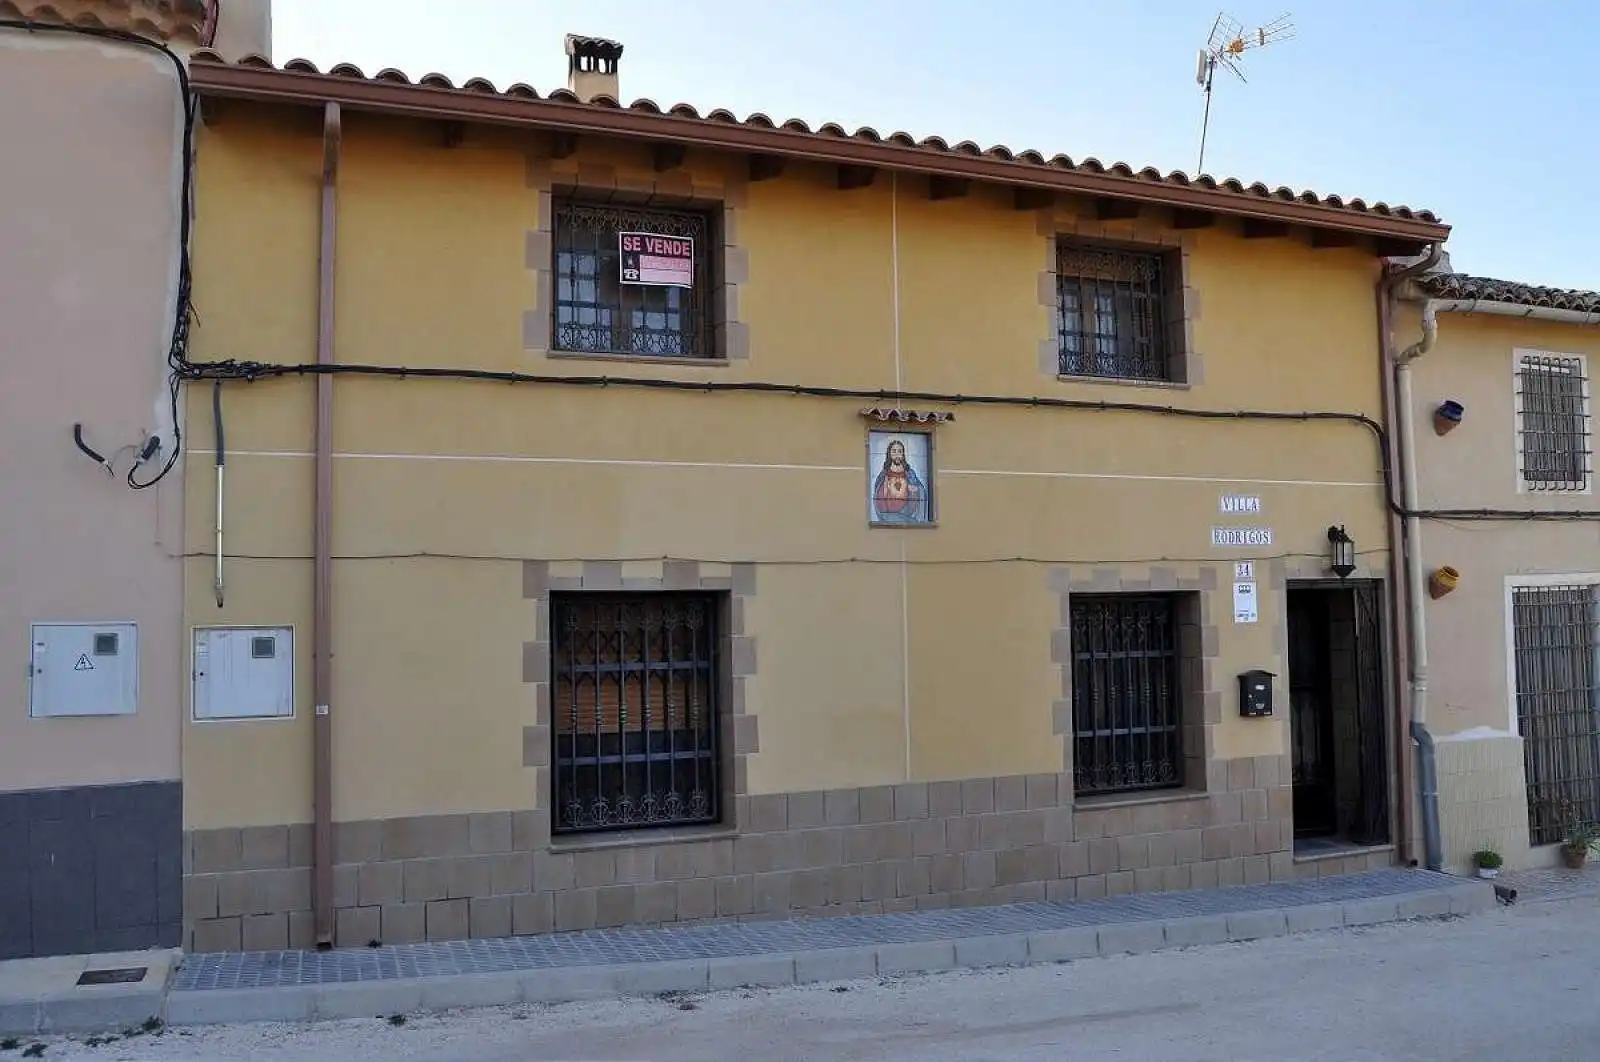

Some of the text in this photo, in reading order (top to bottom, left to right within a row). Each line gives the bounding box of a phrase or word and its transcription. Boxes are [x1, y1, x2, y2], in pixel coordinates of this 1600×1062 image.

[623, 236, 690, 257] SE VENDE
[1223, 496, 1258, 511] VILLA
[1214, 529, 1270, 544] RODRIGOS
